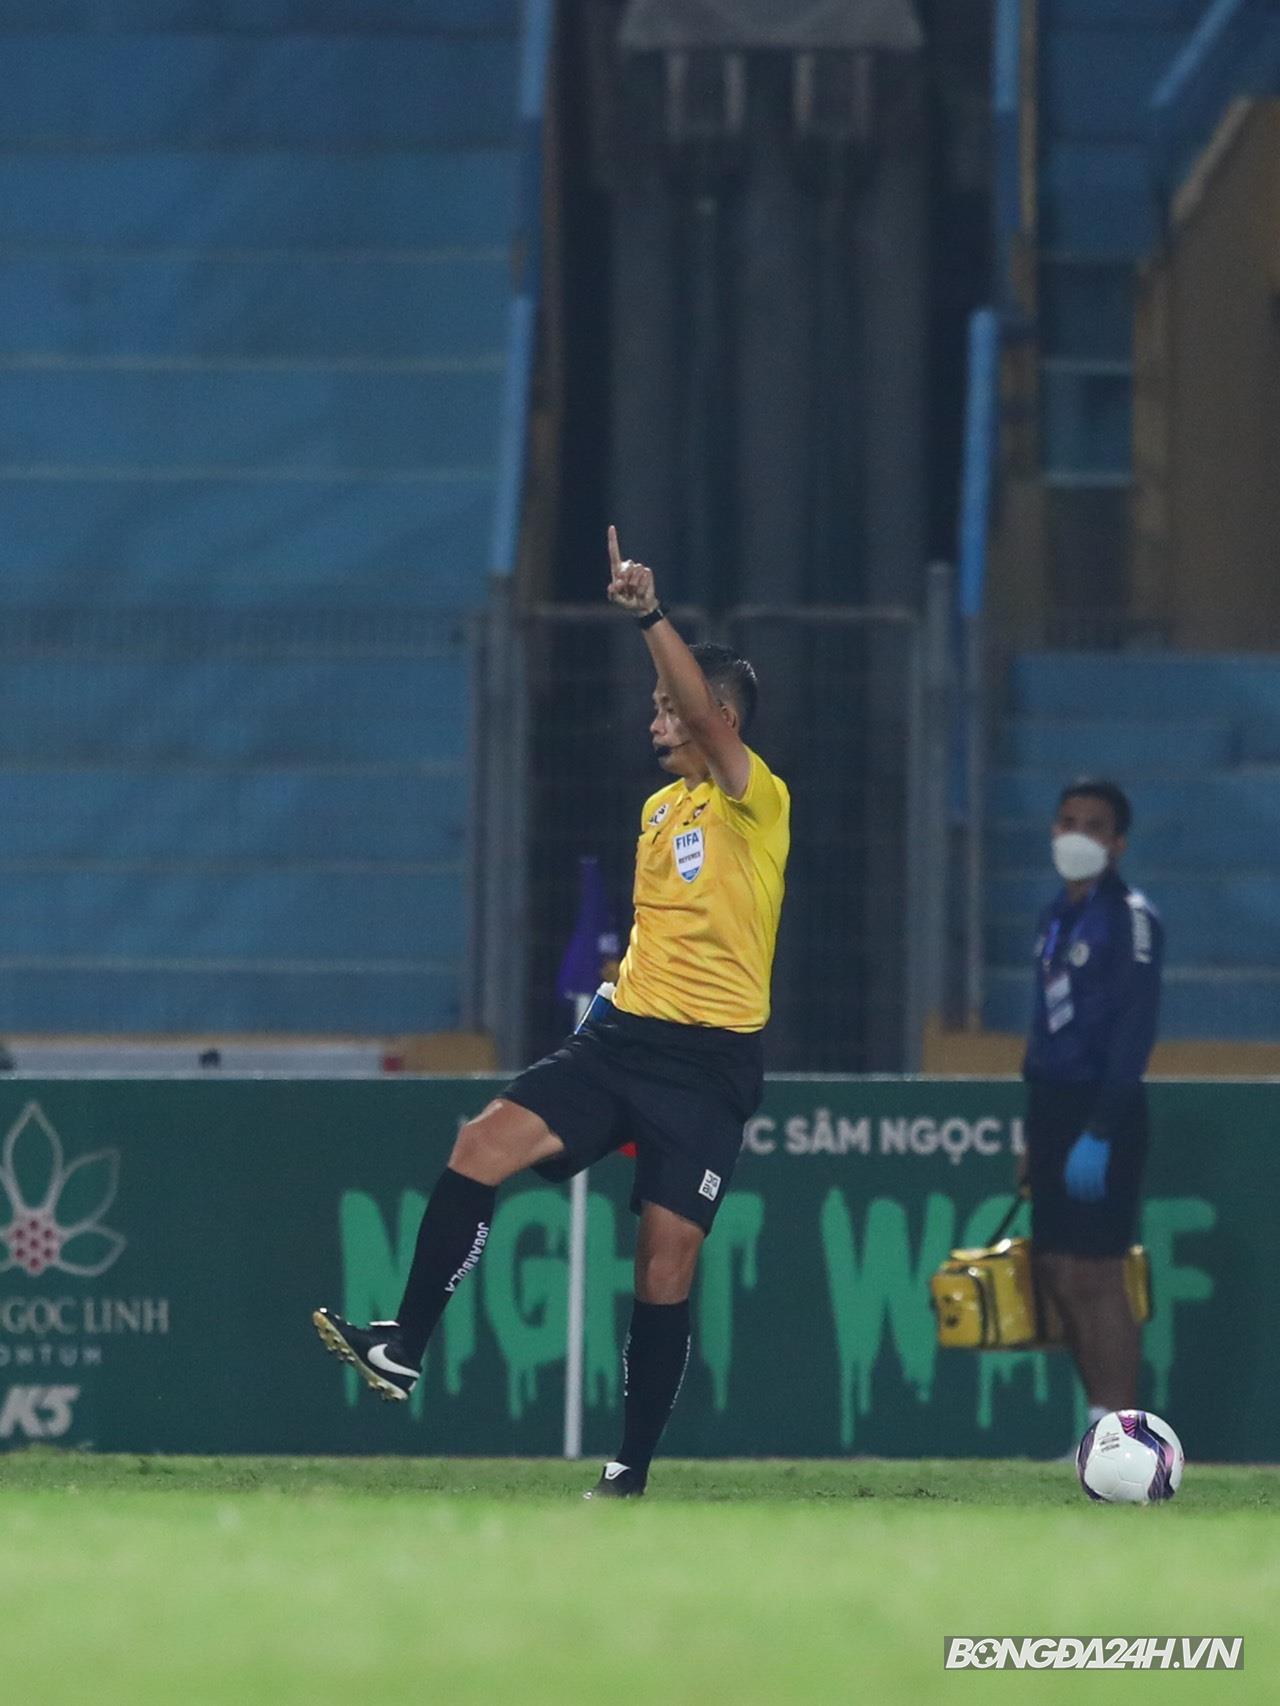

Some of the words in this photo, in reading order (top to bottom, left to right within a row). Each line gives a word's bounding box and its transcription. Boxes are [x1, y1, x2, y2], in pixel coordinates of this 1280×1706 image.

[675, 832, 699, 850] FIFA
[784, 1107, 871, 1155] SÂM
[879, 1117, 1003, 1167] NGỌC
[444, 1221, 490, 1292] JOGARBOLA
[82, 1295, 170, 1335] LINH
